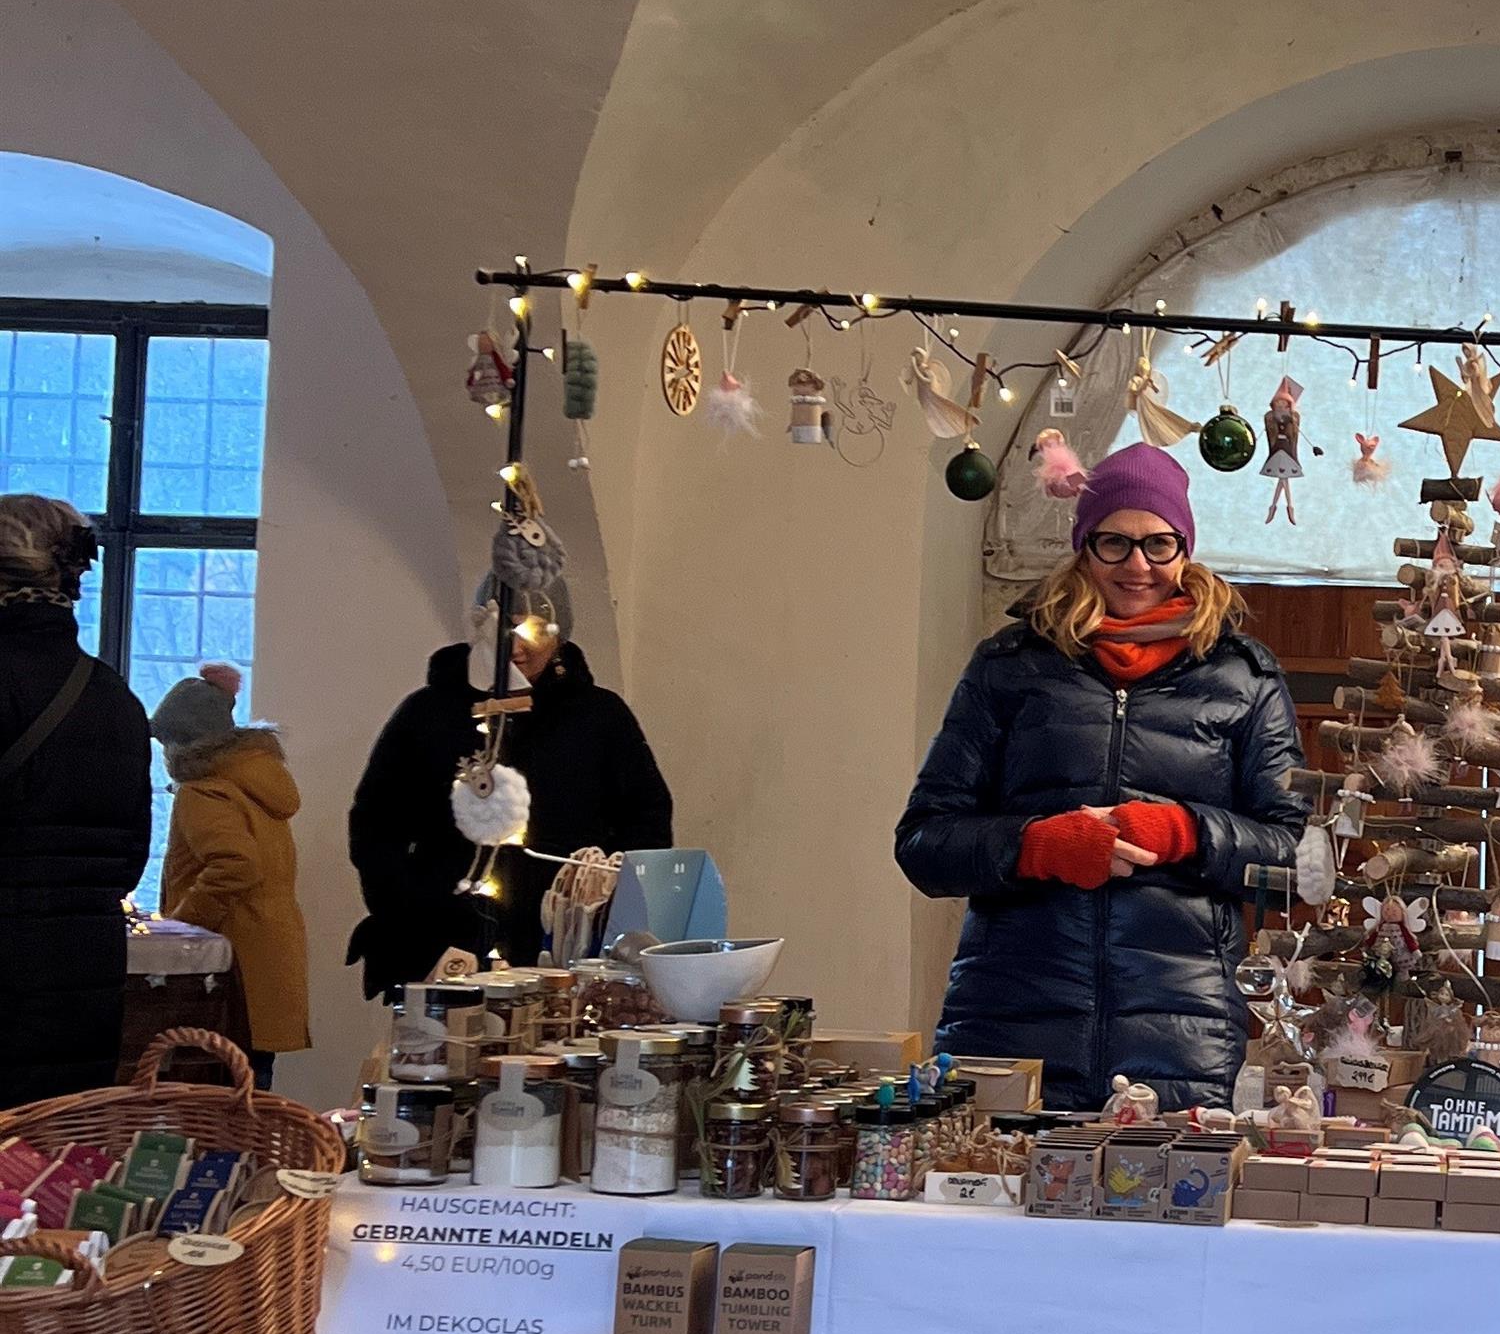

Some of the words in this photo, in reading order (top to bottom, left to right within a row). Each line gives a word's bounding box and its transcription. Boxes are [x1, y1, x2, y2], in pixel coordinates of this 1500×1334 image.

[1444, 1098, 1487, 1115] OHNE
[401, 1196, 576, 1218] HAUSGEMACHT:
[352, 1224, 492, 1244] GEBRANNTE
[499, 1230, 614, 1249] MANDELN
[402, 1254, 445, 1273] 4,50
[452, 1256, 555, 1280] EUR/100g
[623, 1283, 684, 1298] BAMBUS
[723, 1286, 790, 1301] BAMBOO
[622, 1299, 683, 1314] WACKEL
[721, 1303, 791, 1317] TUMBLING
[387, 1314, 411, 1331] IM
[418, 1315, 544, 1334] DEKOGLAS
[630, 1314, 672, 1329] TURM
[728, 1320, 781, 1332] TOWER
